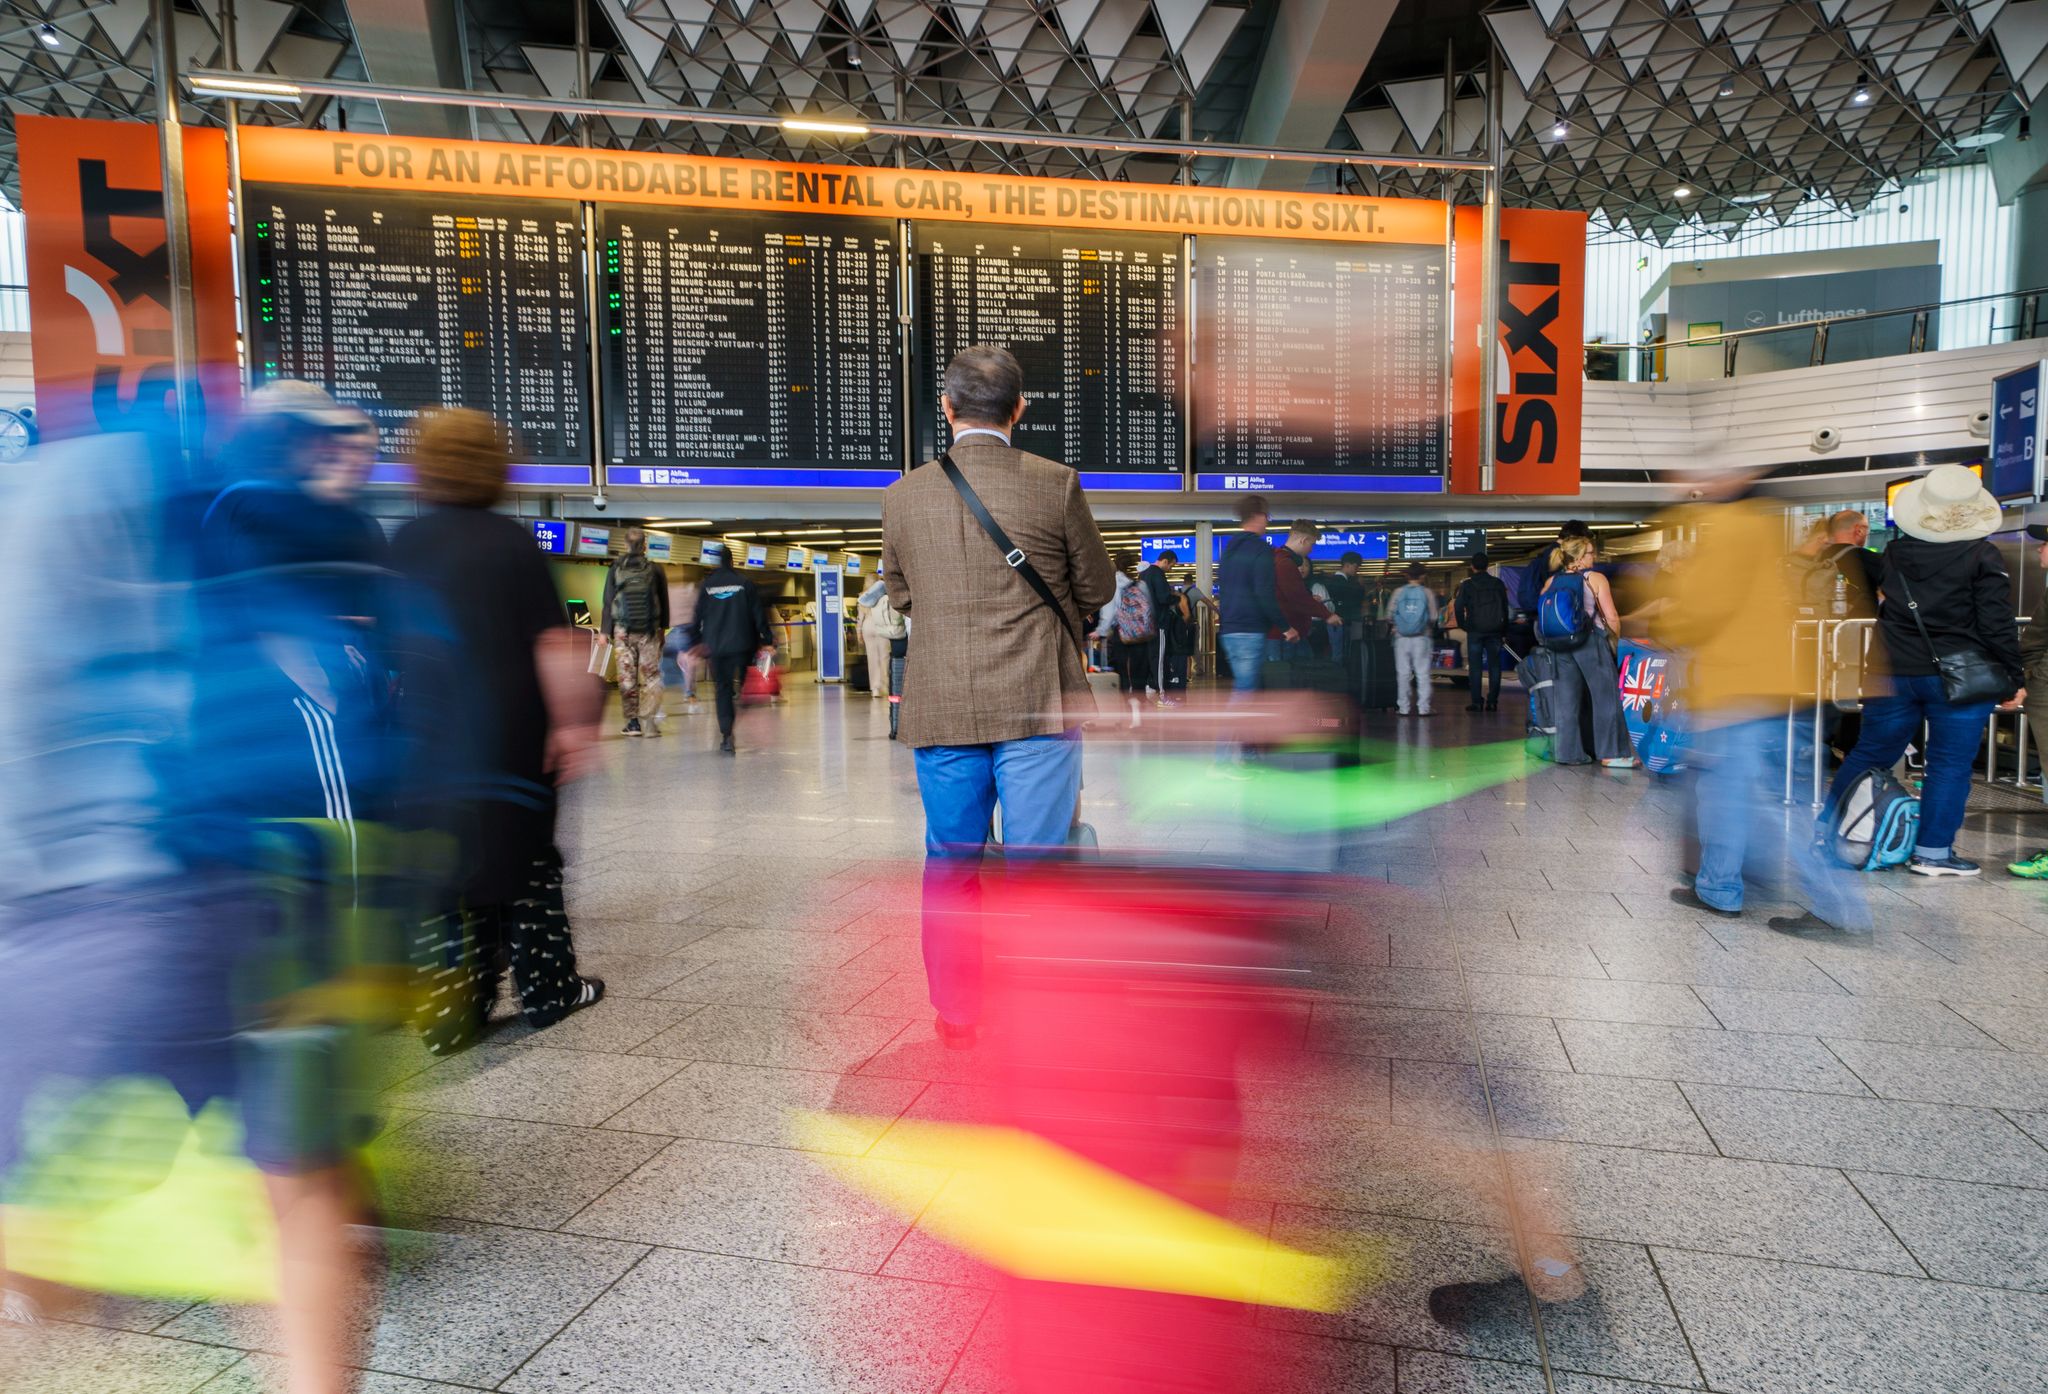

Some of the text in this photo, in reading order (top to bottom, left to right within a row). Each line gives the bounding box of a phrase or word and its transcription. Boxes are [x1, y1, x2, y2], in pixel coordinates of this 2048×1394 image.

[333, 141, 1385, 234] FOR AN AFFORDABLE RENTAL CAR, THE DESTINATION IS SIXT.
[295, 223, 317, 232] 1424
[326, 234, 359, 244] BODRUM
[327, 243, 375, 254] HERAKLION
[622, 240, 633, 249] LH
[669, 242, 716, 253] LYON-SAINT
[669, 251, 889, 269] PRAG A32
[976, 258, 1010, 267] ISTANBUL
[359, 263, 432, 275] BAD-MANNHEIM-K
[669, 260, 761, 272] NEW YORK-J.F.KENNEDY
[976, 266, 1047, 277] PALMA DE MALLORCA
[328, 271, 345, 280] DUS
[349, 272, 412, 283] HBF-SIEGBURG
[670, 269, 707, 278] CAGLIARI
[976, 274, 1035, 284] DORTMUND-KOELN
[329, 280, 371, 290] ISTANBUL
[670, 277, 735, 288] HAMBURG-KASSEL
[876, 286, 885, 295] T4
[329, 290, 418, 301] HAMBURG-CANCELLED
[670, 286, 735, 297] MAILAND-LINATE
[934, 289, 1035, 301] AZ 413 MAILAND-LINATE
[278, 296, 290, 305] LH
[671, 295, 890, 312] BERLIN-BRANDENBURG A14
[952, 298, 969, 306] 1140
[976, 299, 1006, 308] SEVILLA
[305, 307, 368, 317] 141 ANTALYA
[671, 304, 708, 313] BUDAPEST
[977, 307, 1175, 322] ANKARA ESENBOGA C13
[1778, 308, 1867, 324] Lufthansa
[331, 317, 358, 326] SOFIA
[977, 316, 1056, 326] MUENSTER/OSNABRUECK
[331, 326, 404, 337] DORTMUND-KOELN
[625, 328, 636, 336] UA
[717, 331, 736, 340] HARE
[671, 321, 890, 337] ZUERICH A24
[977, 324, 1056, 334] STUTTGART-CANCELLED
[977, 332, 1044, 342] MAILAND-MALPENSA
[645, 337, 763, 349] 3404 MUENCHEN-STUTTGART-U
[332, 345, 436, 356] BERLIN HBF-KASSEL BH
[672, 347, 705, 356] DRESDEN
[1496, 239, 1560, 464] SIXT
[302, 353, 324, 361] 3402
[333, 354, 436, 365] MUENCHEN-STUTTGART-U
[673, 356, 701, 364] KRAKAU
[673, 364, 692, 373] GENF
[334, 372, 356, 381] PISA
[673, 373, 891, 387] HAMBURG A13
[335, 381, 577, 396] MUENCHEN A21
[674, 381, 891, 395] HANNOVER A20
[1163, 386, 1175, 394] A17
[674, 390, 891, 403] DUESSELDORF A52
[674, 399, 707, 407] BILLUND
[563, 406, 578, 414] A34
[674, 407, 743, 416] LONDON-HEATHROW
[648, 415, 712, 424] 1102 SALZBURG
[675, 424, 712, 433] BRUESSEL
[1032, 423, 1057, 431] GAULLE
[675, 433, 739, 442] DRESDEN-ERFURT
[676, 441, 744, 450] WROCLAW/BRESLAU
[2024, 436, 2034, 460] B
[630, 449, 641, 457] LH
[676, 450, 735, 458] LEIPZIG/HALLE
[879, 453, 892, 461] A25
[536, 530, 557, 540] 428-
[1348, 533, 1365, 546] A,Z
[1183, 538, 1190, 549] C
